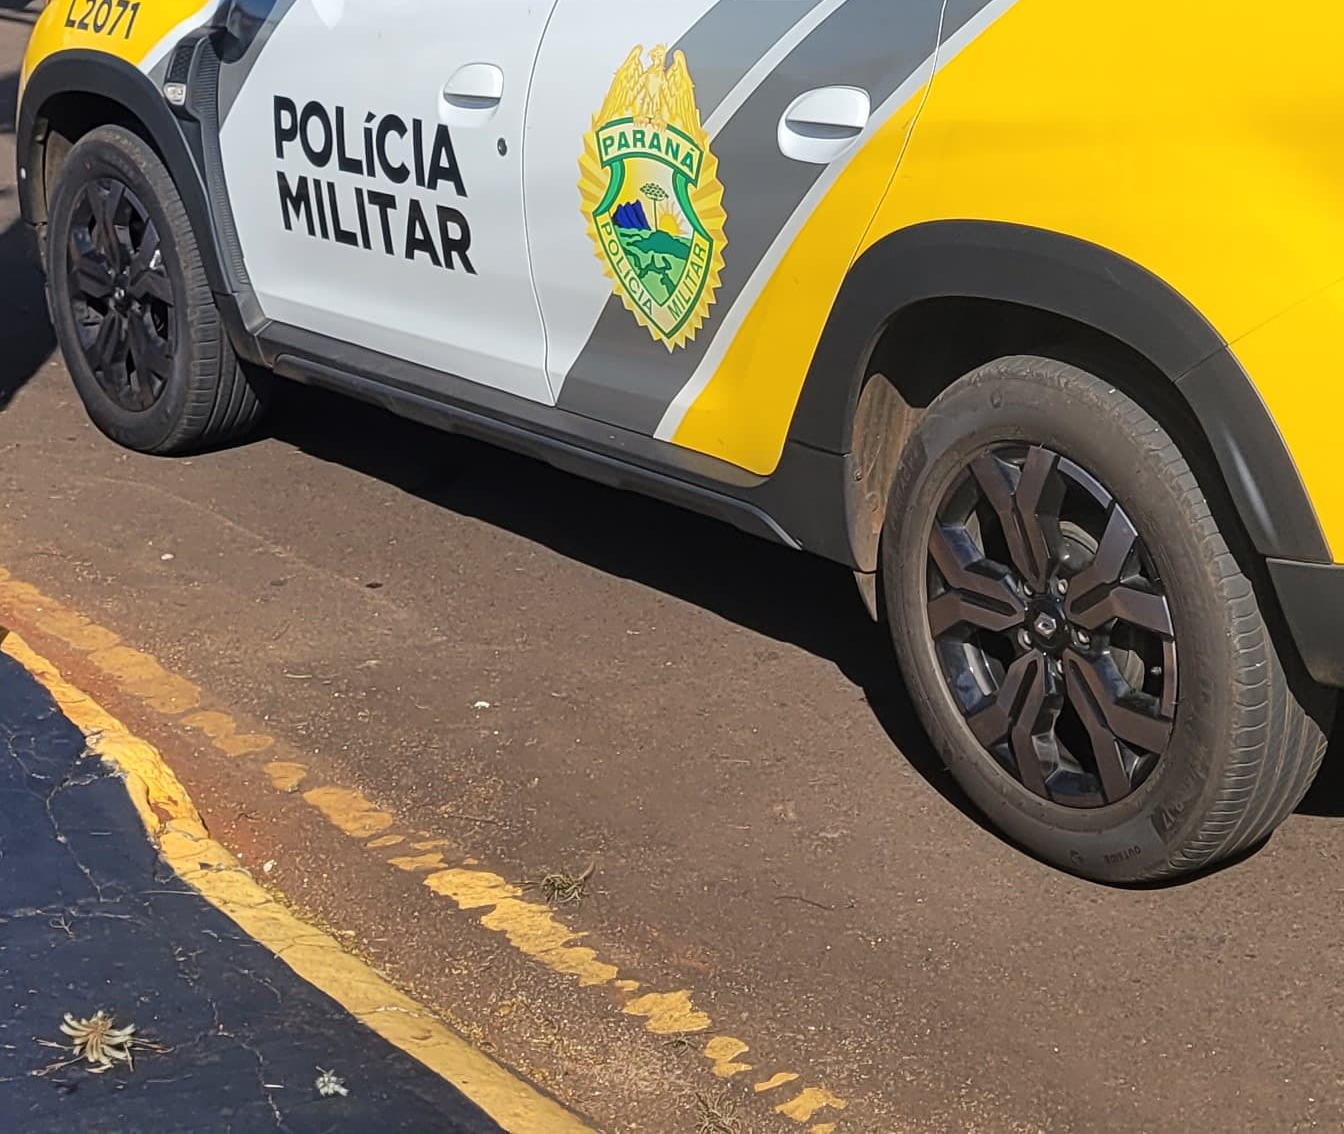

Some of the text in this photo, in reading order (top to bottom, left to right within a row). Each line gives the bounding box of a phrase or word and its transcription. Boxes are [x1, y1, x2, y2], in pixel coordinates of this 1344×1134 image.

[273, 94, 468, 198] POLÍCIA
[602, 129, 696, 174] PARANÁ
[276, 170, 478, 275] MILITAR
[667, 242, 707, 321] MILITAR
